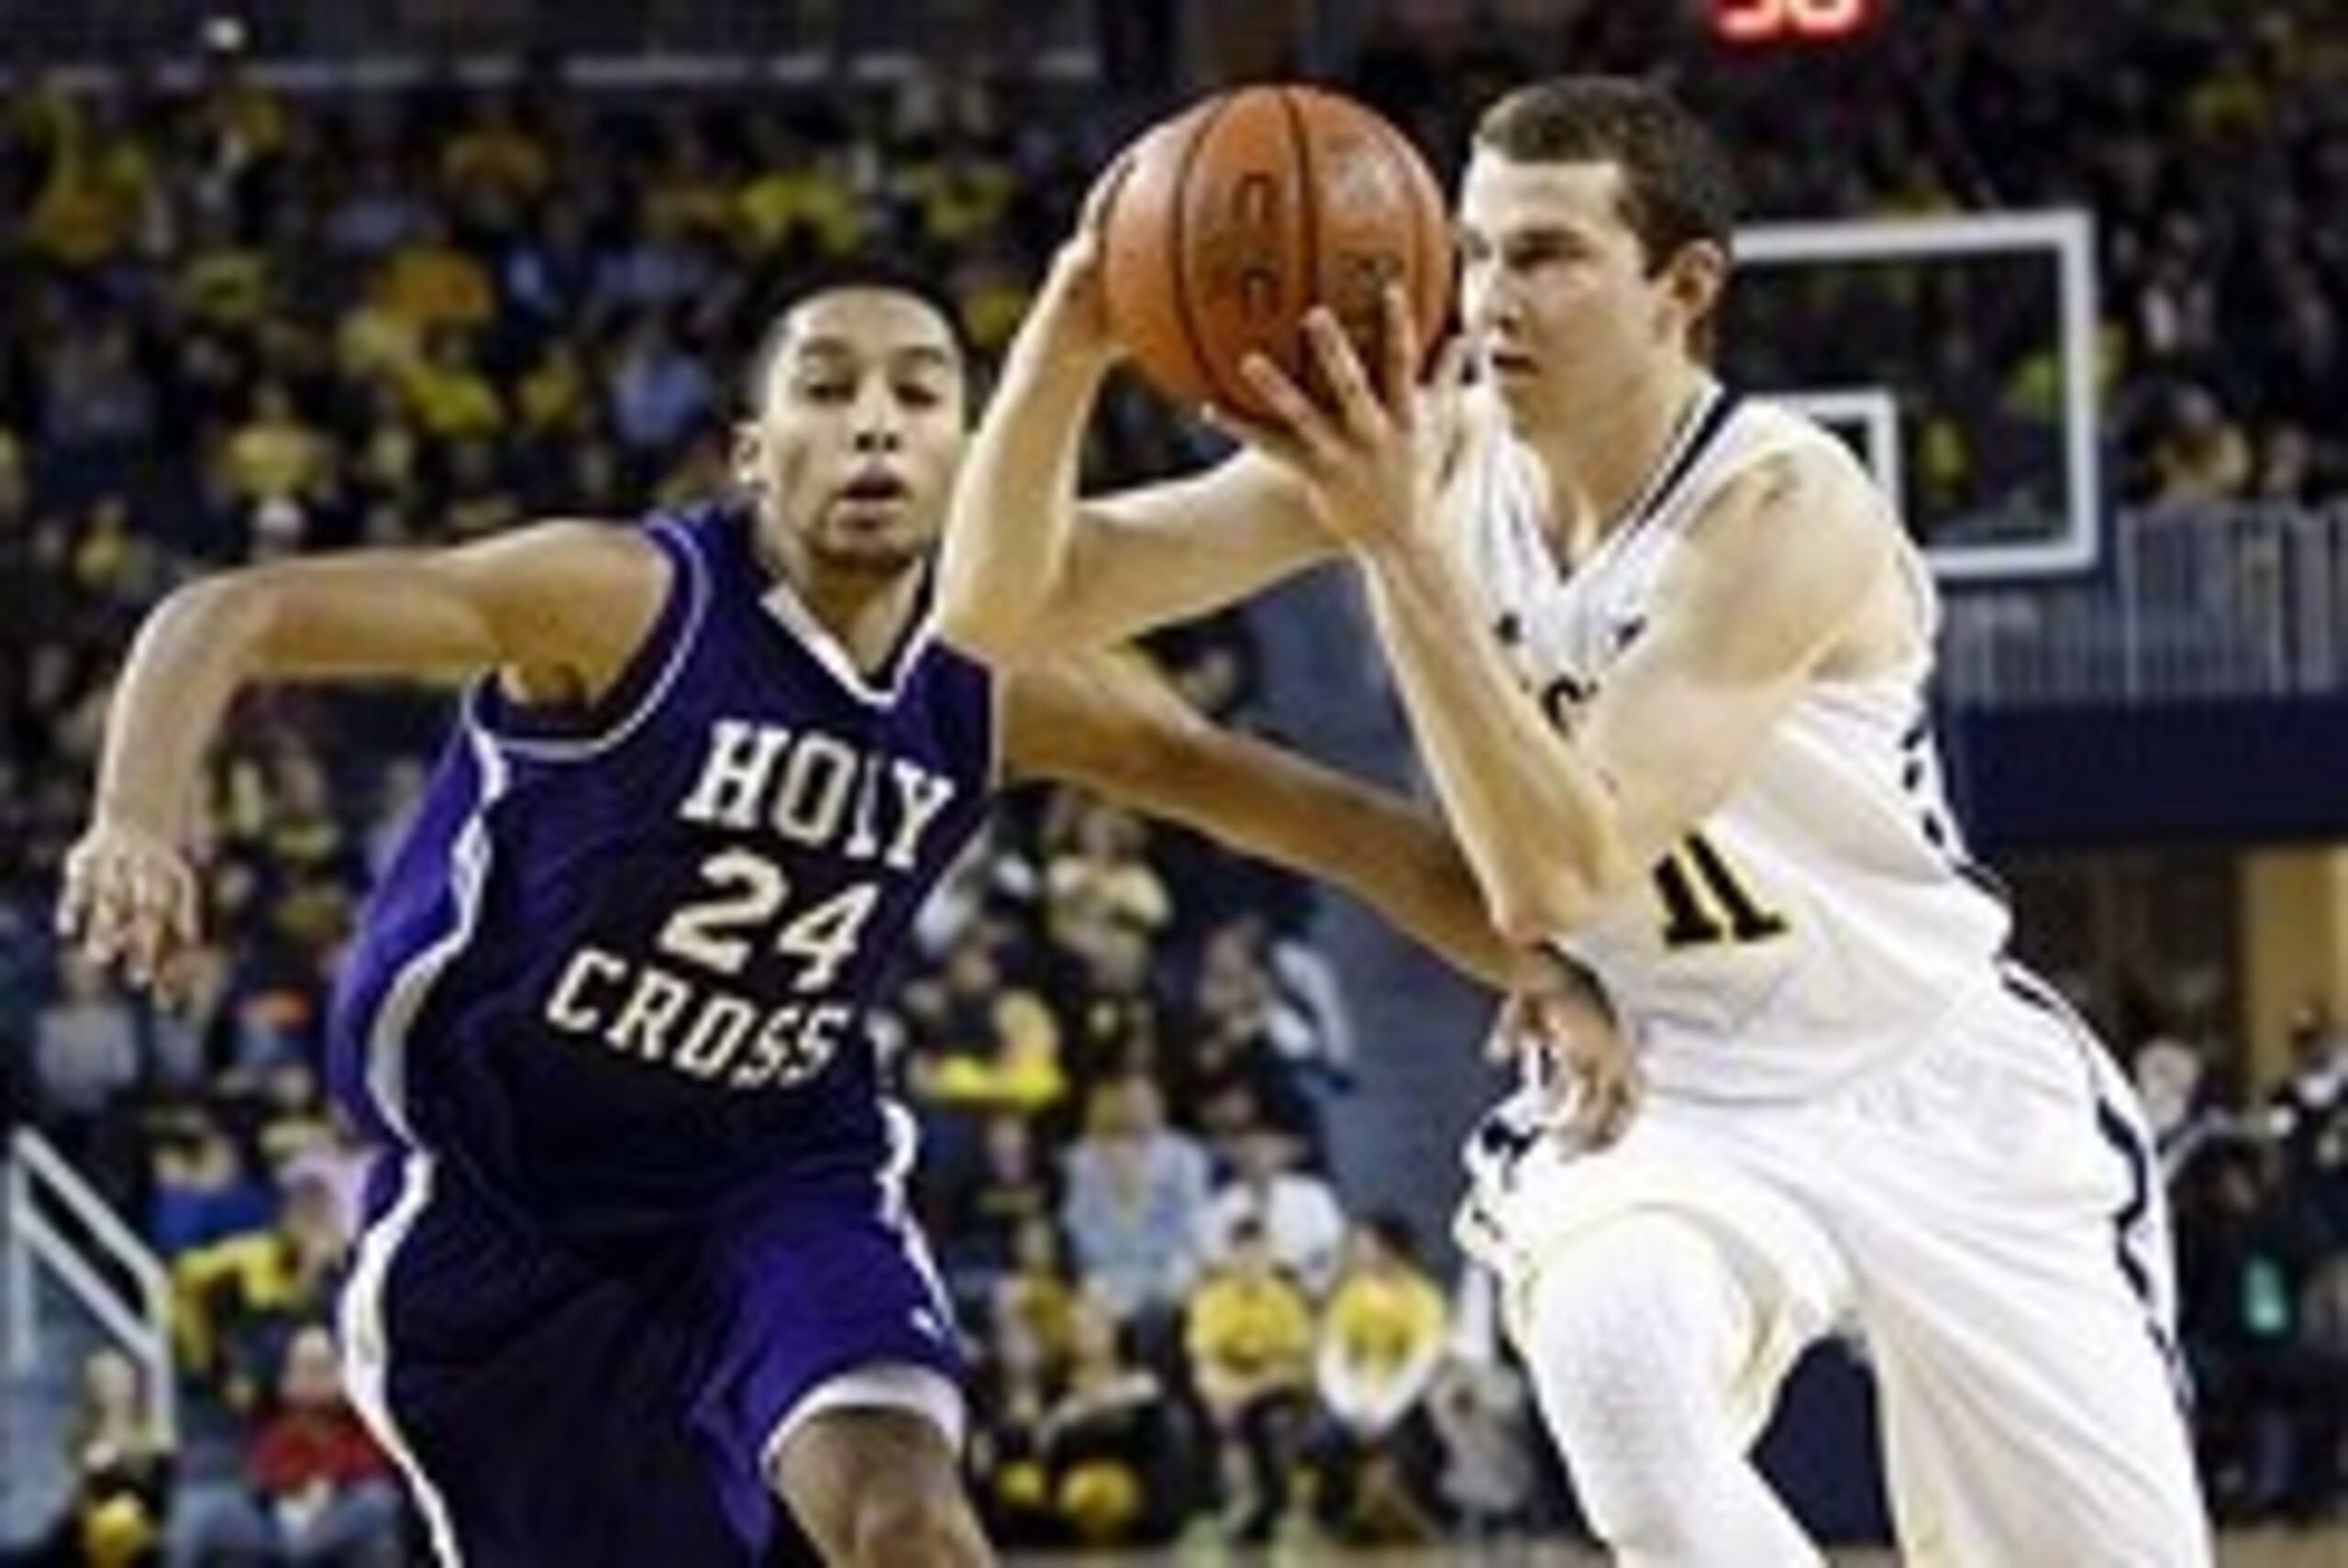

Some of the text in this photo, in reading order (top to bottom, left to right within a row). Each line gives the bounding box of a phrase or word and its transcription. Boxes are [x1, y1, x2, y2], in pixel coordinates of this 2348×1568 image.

[657, 848, 878, 990] 24
[1654, 830, 1789, 946] 11
[547, 947, 848, 1088] CROSS
